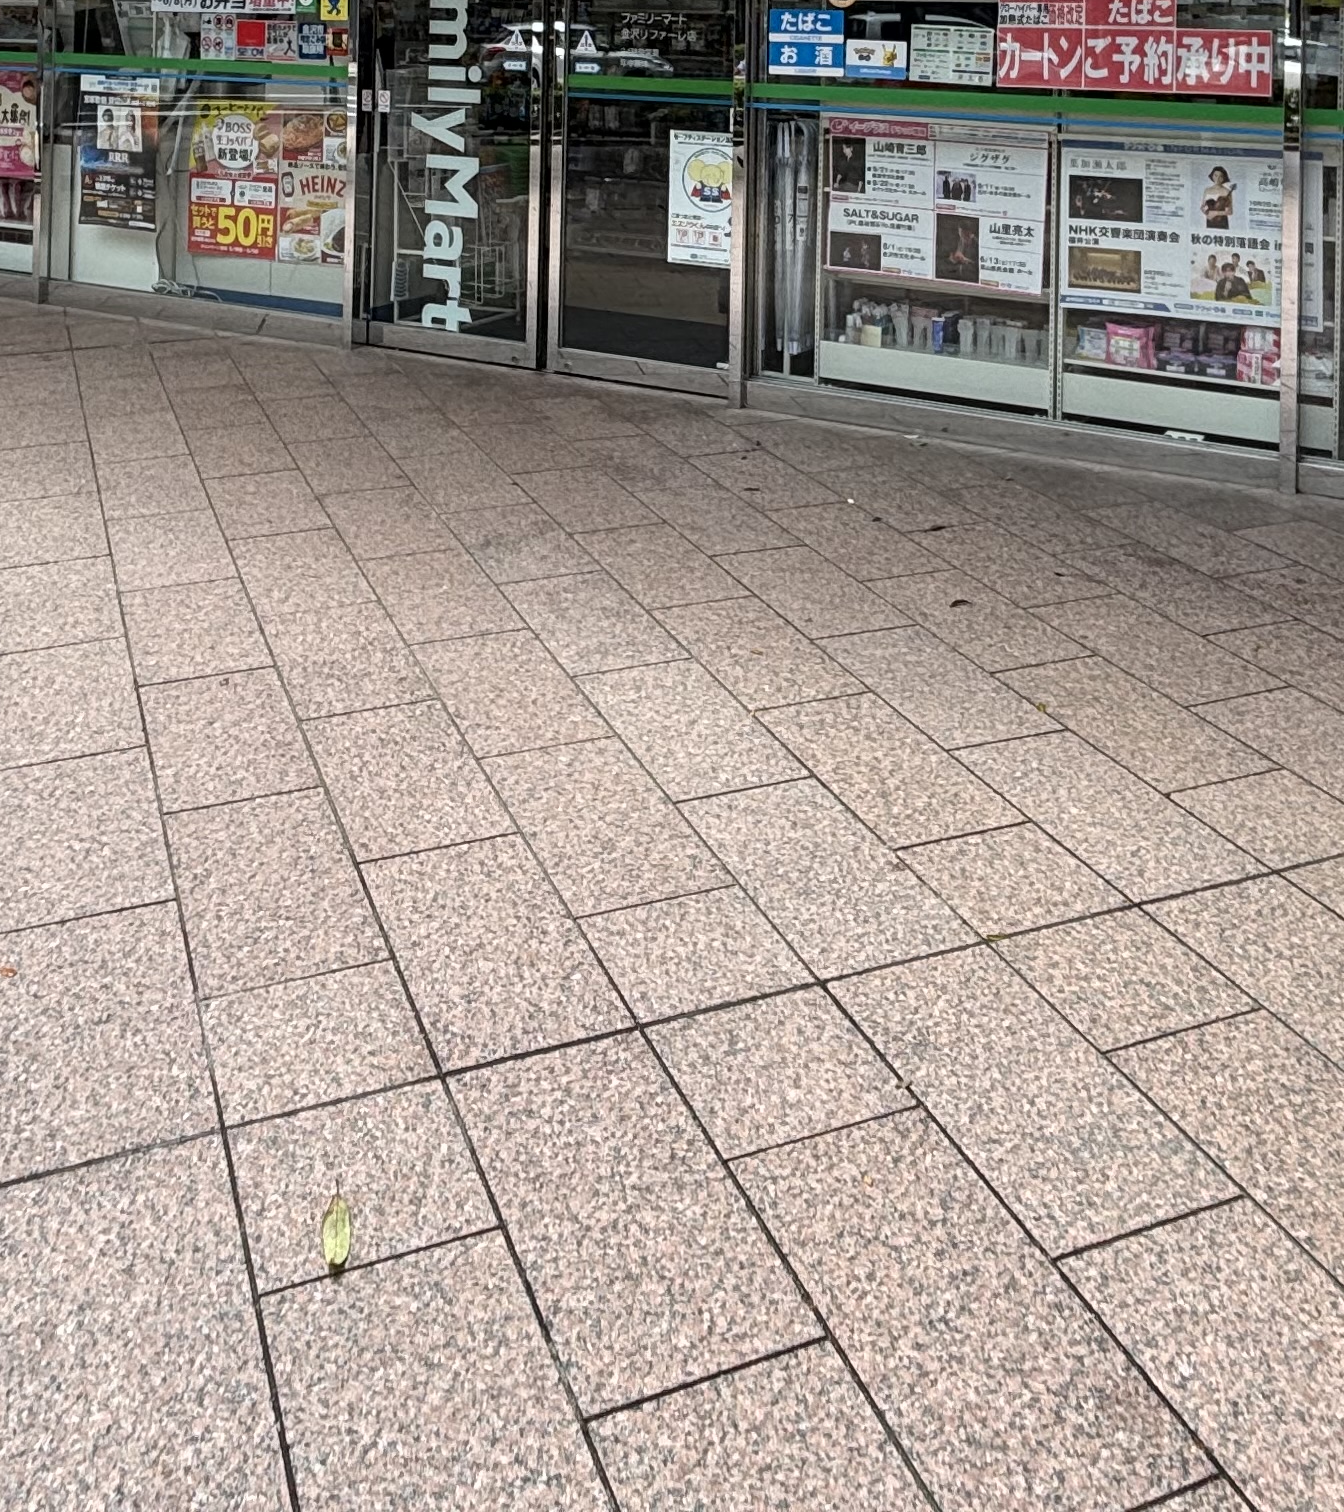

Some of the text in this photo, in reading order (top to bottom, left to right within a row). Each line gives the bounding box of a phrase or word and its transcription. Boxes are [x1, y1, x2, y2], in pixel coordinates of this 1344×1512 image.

[620, 12, 688, 25] ファミリーマート
[780, 11, 833, 32] たばこ
[620, 27, 697, 42] 金沢リファーレ店
[998, 32, 1271, 88] カートンご予約承り中
[224, 121, 252, 134] BOSS
[299, 174, 347, 198] HEINZ
[843, 207, 920, 224] SALT&SUGAR
[989, 222, 1036, 238] 山里亮太
